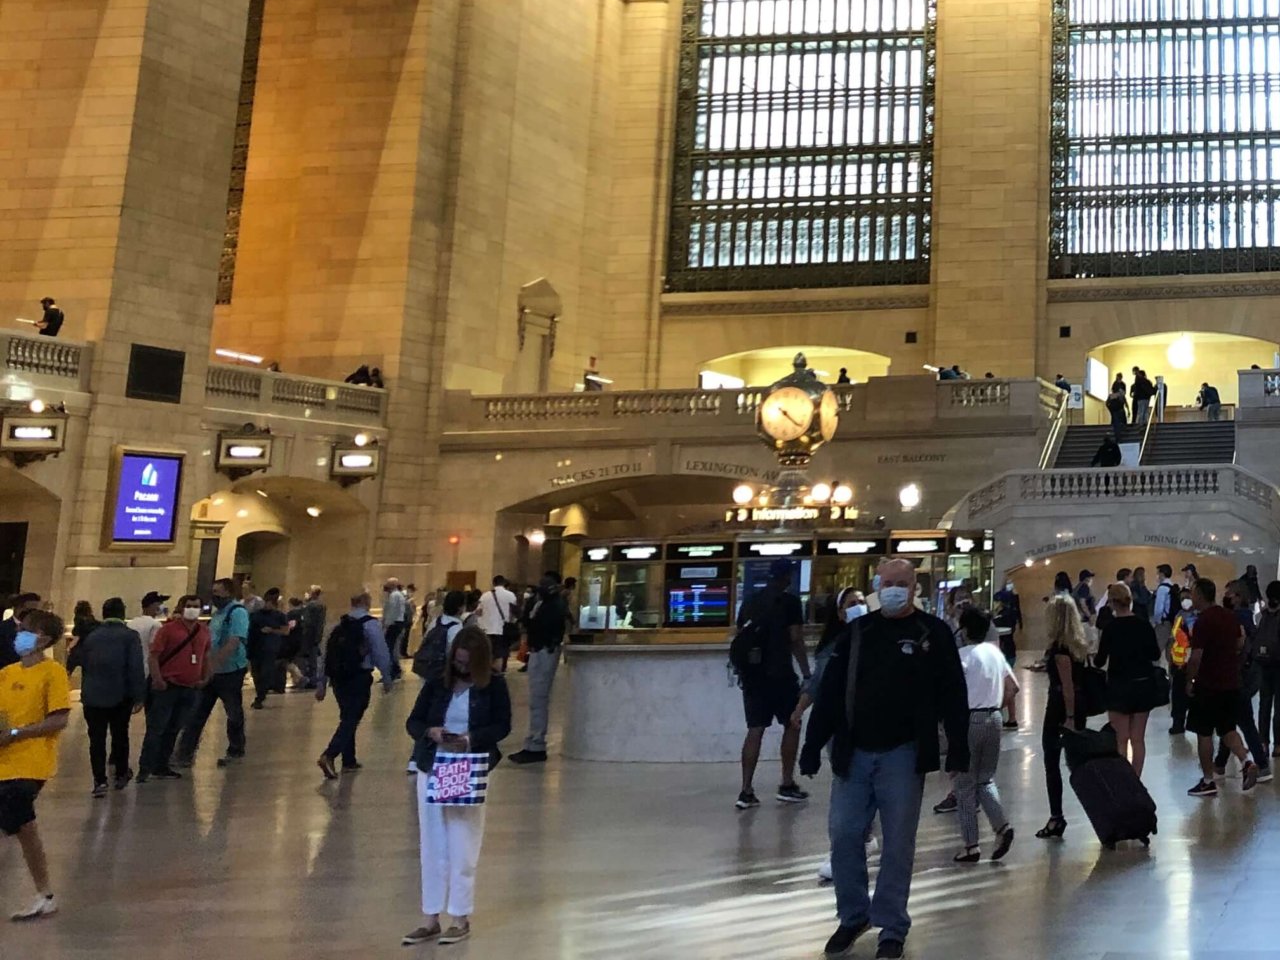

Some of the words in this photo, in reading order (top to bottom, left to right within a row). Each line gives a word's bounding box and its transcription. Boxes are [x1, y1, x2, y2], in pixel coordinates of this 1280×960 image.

[549, 469, 596, 488] TRACKS
[599, 467, 609, 477] 21
[613, 464, 630, 475] TO
[685, 460, 759, 477] LEXINGTON
[752, 508, 819, 520] Information
[1144, 535, 1178, 544] DINING
[438, 760, 468, 778] BATH
[442, 772, 473, 787] BODY
[432, 783, 473, 801] WORKS
